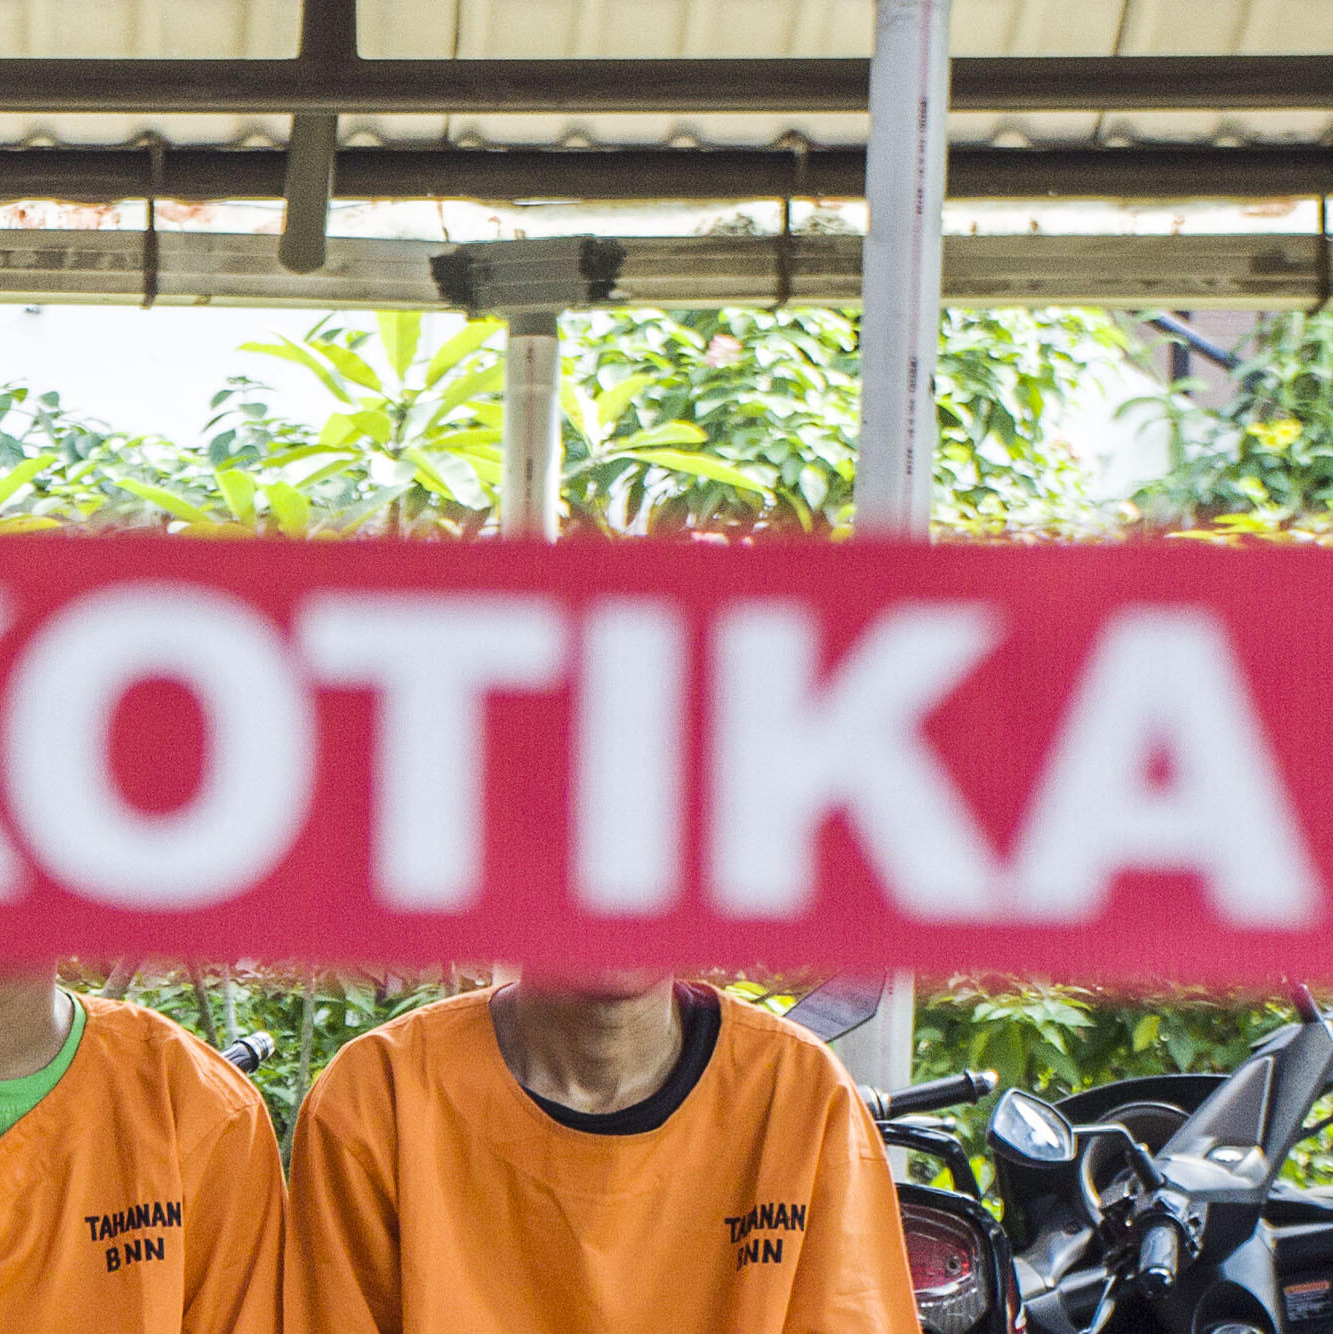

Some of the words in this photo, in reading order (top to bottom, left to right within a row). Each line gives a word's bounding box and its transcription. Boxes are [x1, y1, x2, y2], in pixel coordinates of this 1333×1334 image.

[84, 1201, 182, 1242] TAHANAN
[724, 1202, 807, 1245] TANAN
[105, 1237, 165, 1273] BNN
